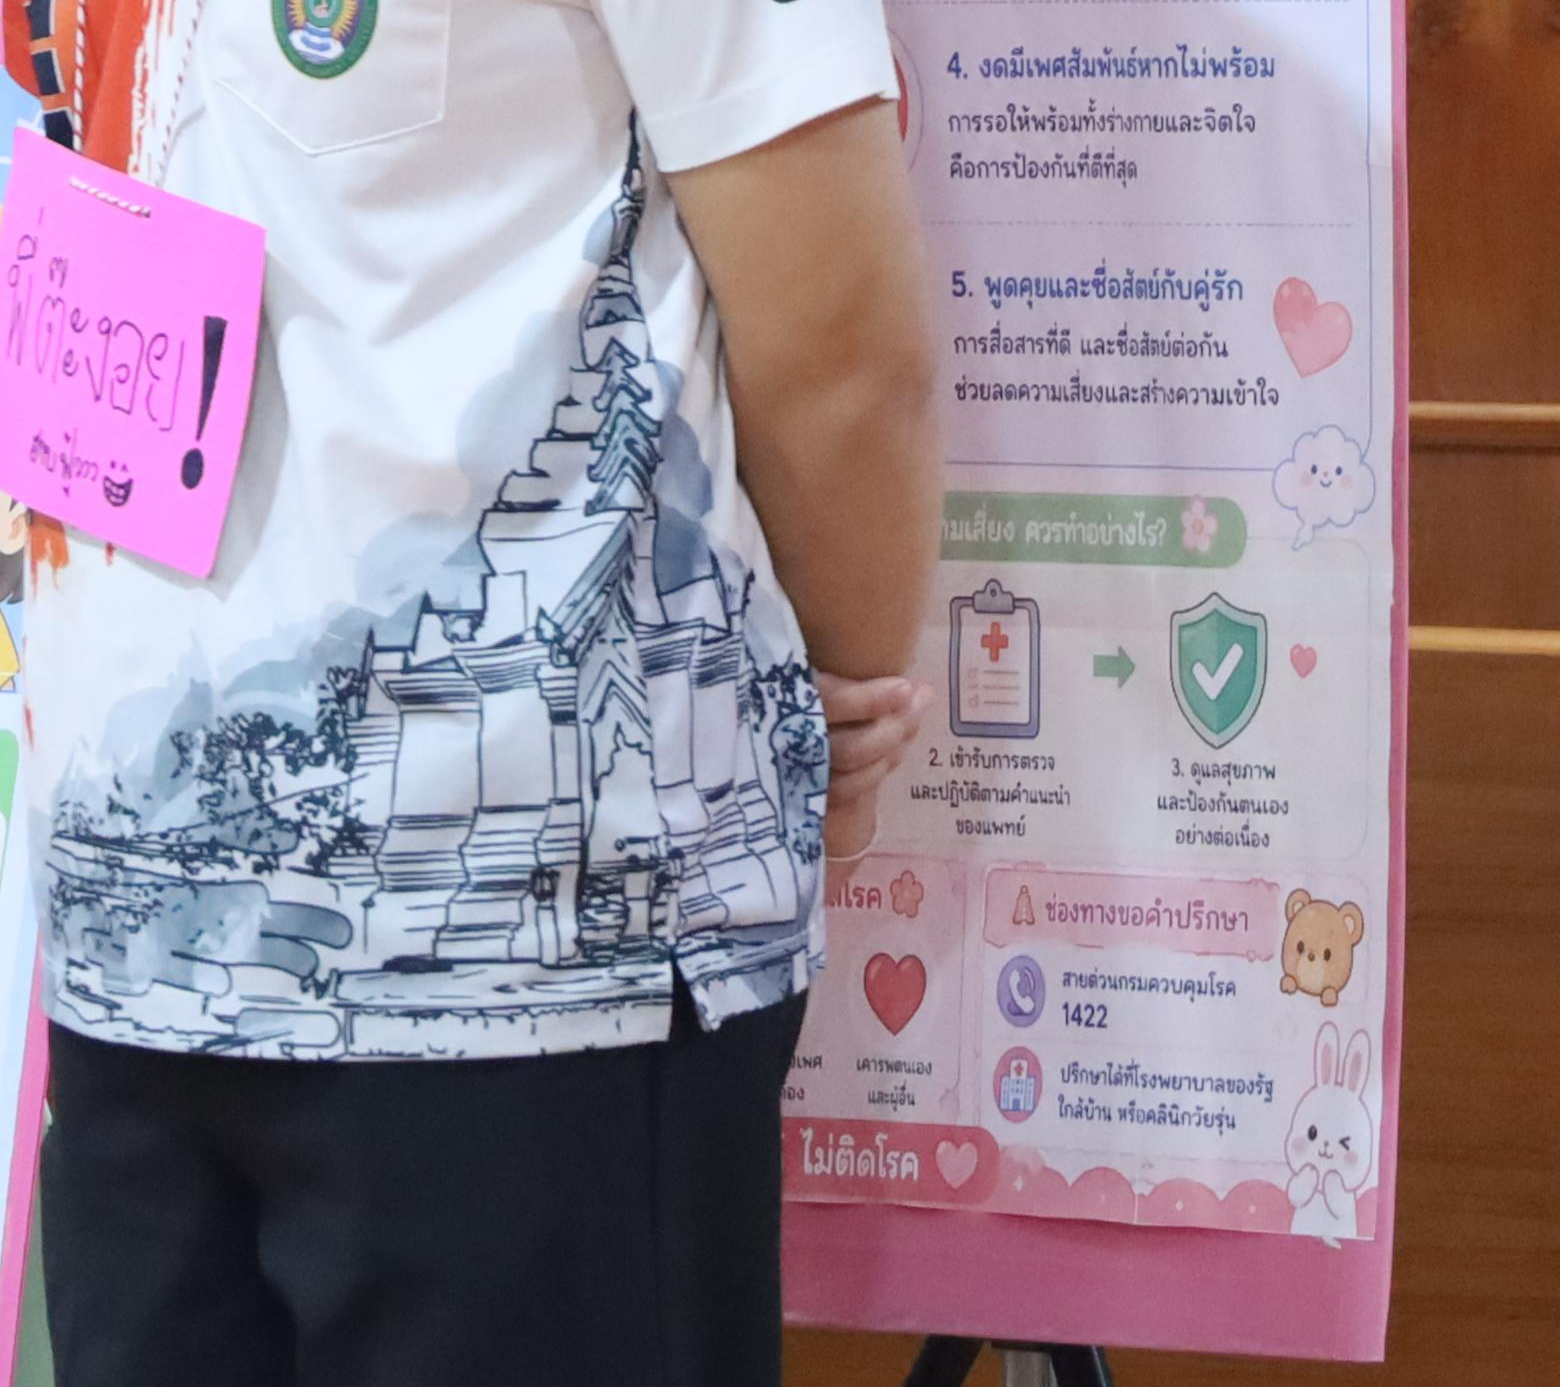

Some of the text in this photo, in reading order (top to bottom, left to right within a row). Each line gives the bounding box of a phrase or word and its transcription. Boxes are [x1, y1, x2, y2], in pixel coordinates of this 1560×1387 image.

[947, 44, 1276, 81] 4. งดมีเพศสัมพันธ์หากไม่พร้อม
[948, 98, 1257, 136] การรอให้พร้อมทั้งร่างกายและจิตใจ
[949, 144, 1138, 188] คือการป้องกันที่ดีที่สุด
[951, 271, 974, 300] 5.
[954, 320, 1072, 358] การสื่อสารที่ดี
[954, 369, 1280, 407] ช่วยลดความเสี่ยงและสร้างความเข้าใจ
[1025, 510, 1168, 548] ควรทำอย่างไร?
[949, 745, 1056, 773] เข้ารับการตรวจ
[910, 778, 1071, 811] และปฏิบัติตามคำแนะนำ
[1190, 760, 1277, 796] ดูแลสุขภาพ
[1157, 790, 1290, 819] และป้องกันตนเอง
[956, 813, 1027, 838] ของแพทย์
[1175, 822, 1272, 851] อย่างต่อเนื่อง
[1045, 884, 1250, 934] ช่องทางขอคำปรึกษา
[1062, 968, 1237, 1004] สายด่วนกรมควบคุมโรค
[1062, 1002, 1109, 1030] 1422
[1060, 1060, 1274, 1103] ปรึกษาได้ที่โรงพยาบาลของรัฐ
[1058, 1092, 1236, 1138] ใกล้บ้าน หรือคลินิกวัยรุ่น
[801, 1126, 920, 1182] ไม่ติดโรค
